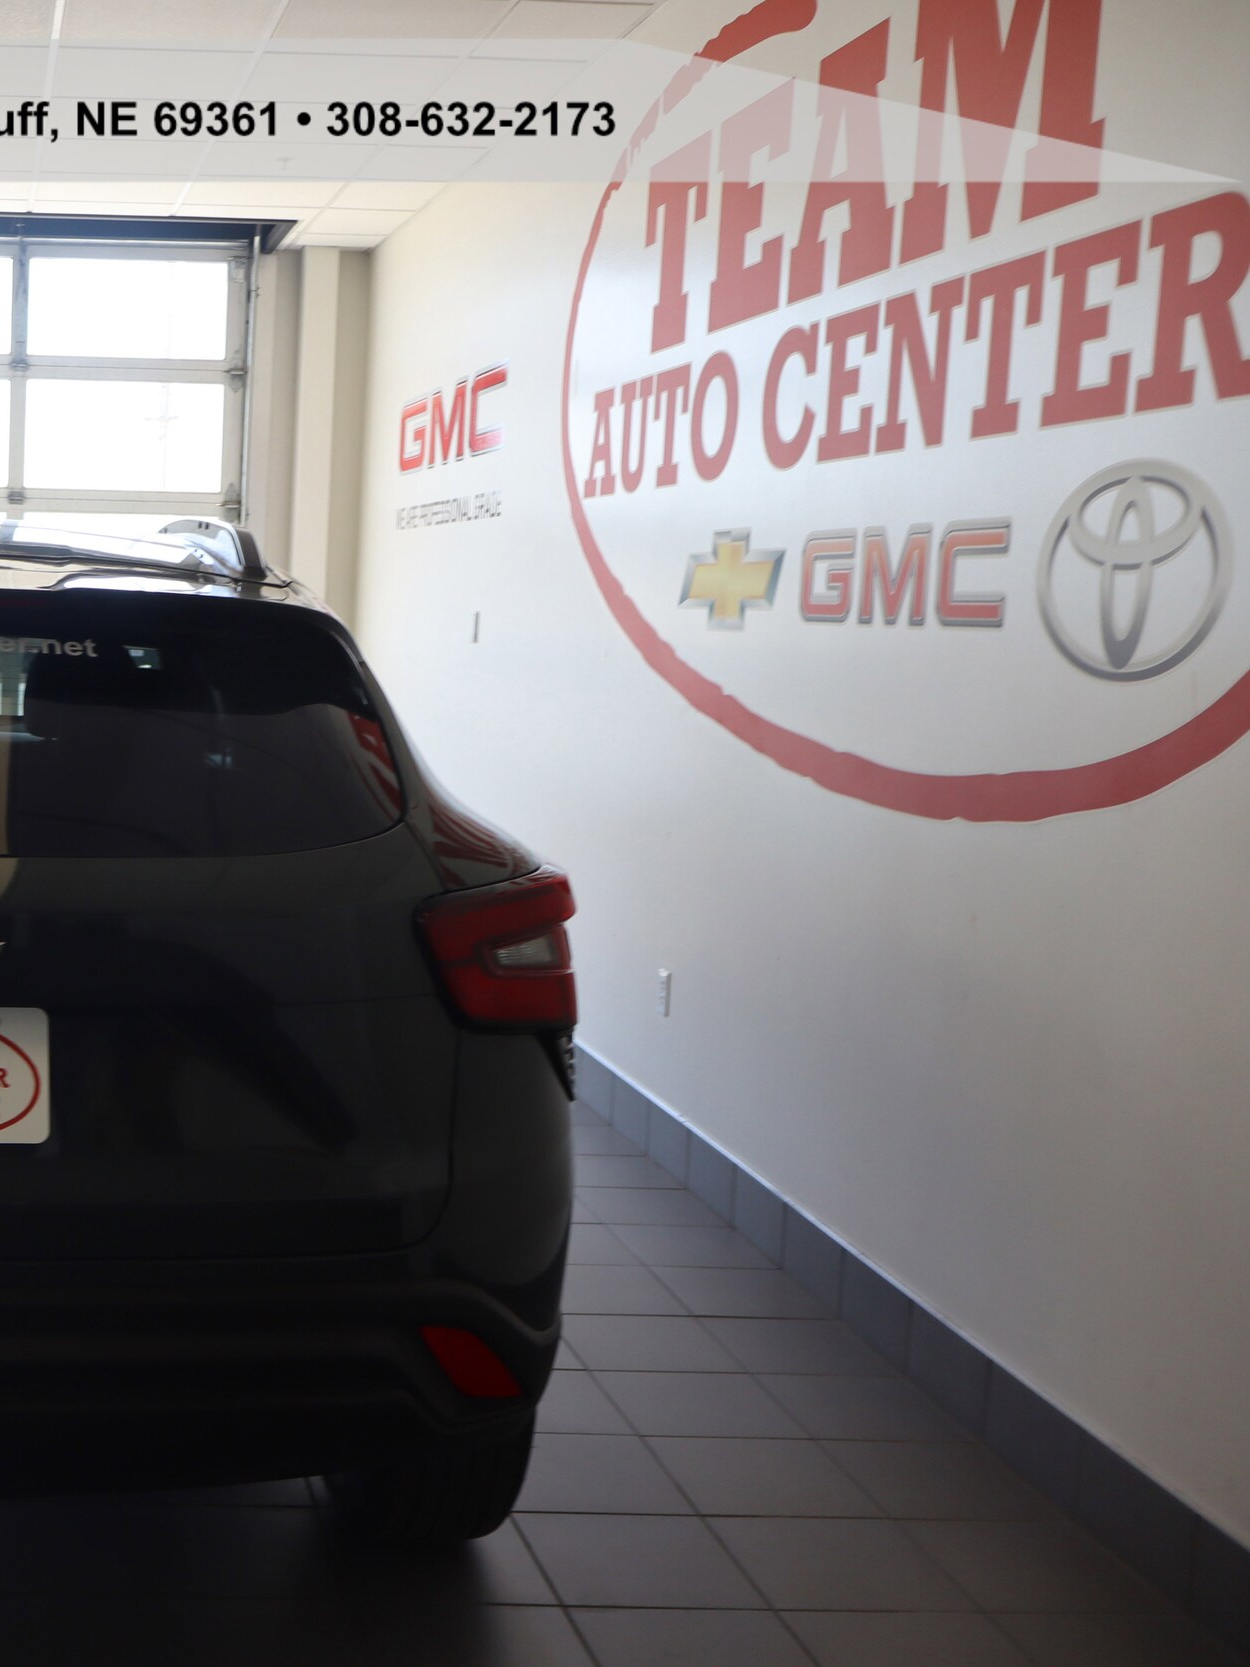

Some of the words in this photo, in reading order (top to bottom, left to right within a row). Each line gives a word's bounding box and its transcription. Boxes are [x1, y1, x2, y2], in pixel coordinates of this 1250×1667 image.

[645, 0, 1107, 355] TEAM
[398, 358, 510, 476] GMC
[583, 350, 740, 499] AUTO
[762, 190, 1250, 471] CENTER
[799, 516, 1012, 628] GMC
